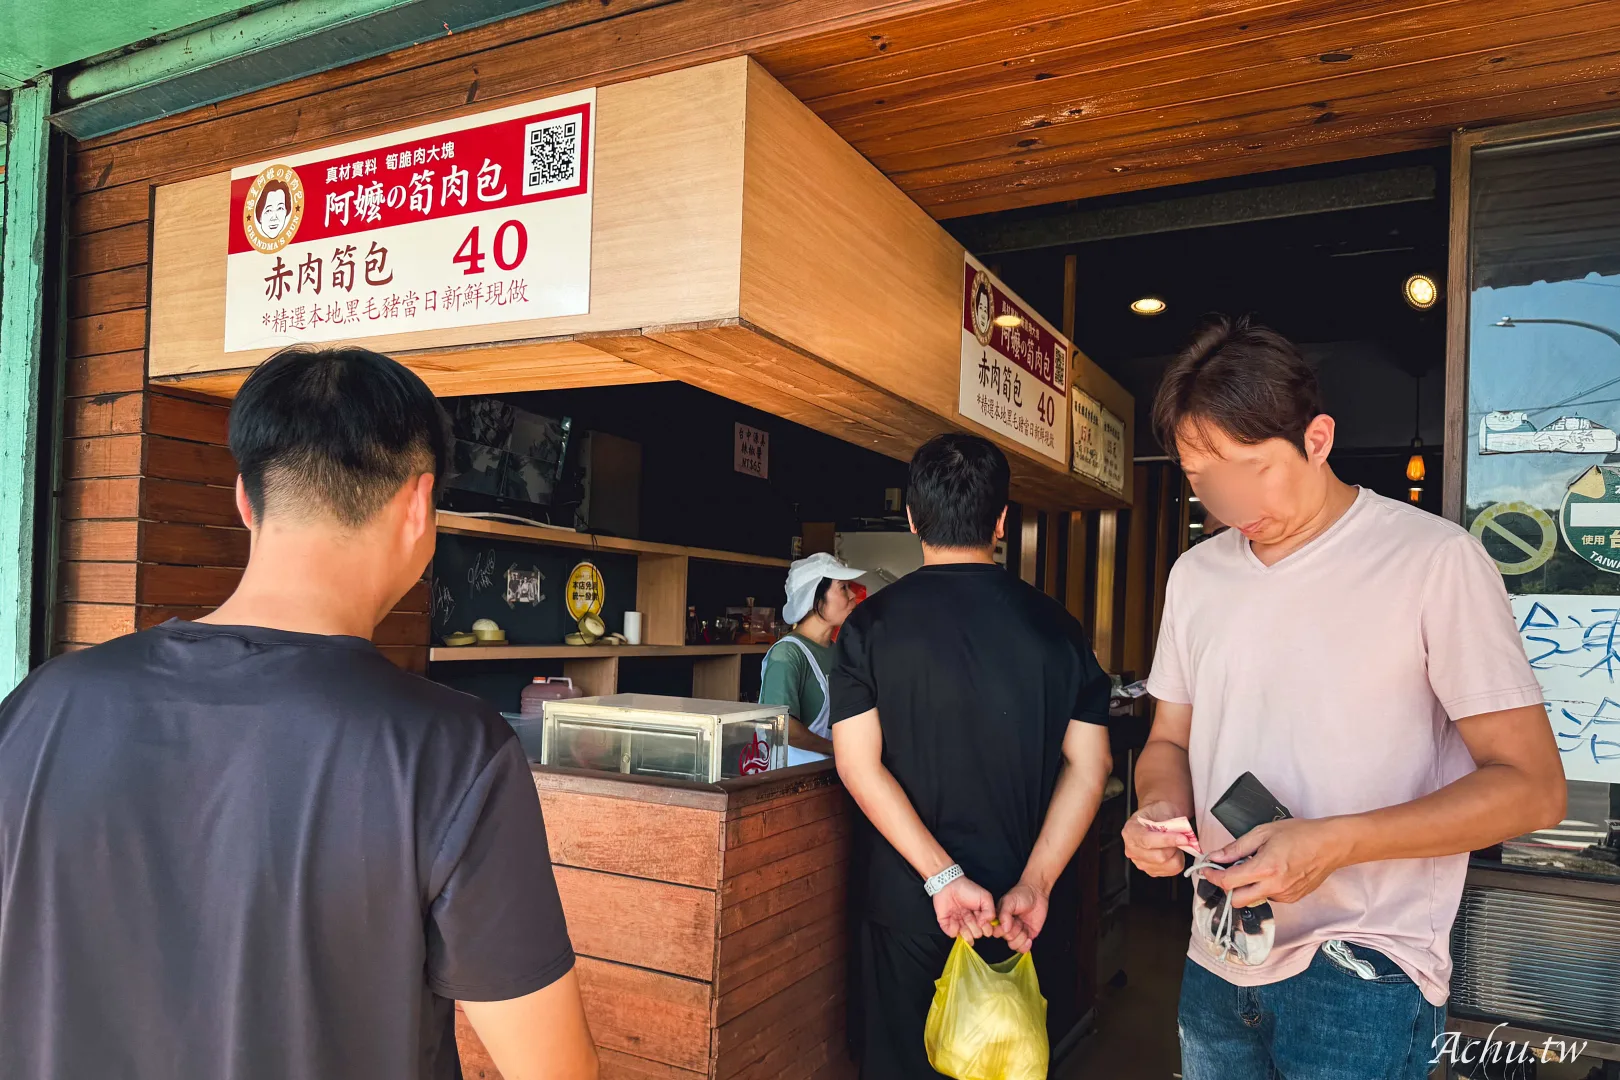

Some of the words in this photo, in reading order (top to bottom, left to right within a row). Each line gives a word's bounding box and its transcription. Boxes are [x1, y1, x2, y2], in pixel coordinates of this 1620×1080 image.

[325, 159, 378, 184] 真材實料
[385, 141, 455, 169] 筍脆肉大塊
[324, 157, 508, 228] 阿嬤の筍肉包
[246, 224, 286, 251] GRANDMA'S
[286, 215, 300, 238] BUN
[452, 219, 528, 276] 40
[264, 241, 394, 302] 赤肉筍包
[978, 350, 1023, 408] 赤肉筍包
[1037, 391, 1055, 428] 40
[1581, 534, 1605, 546] 使用
